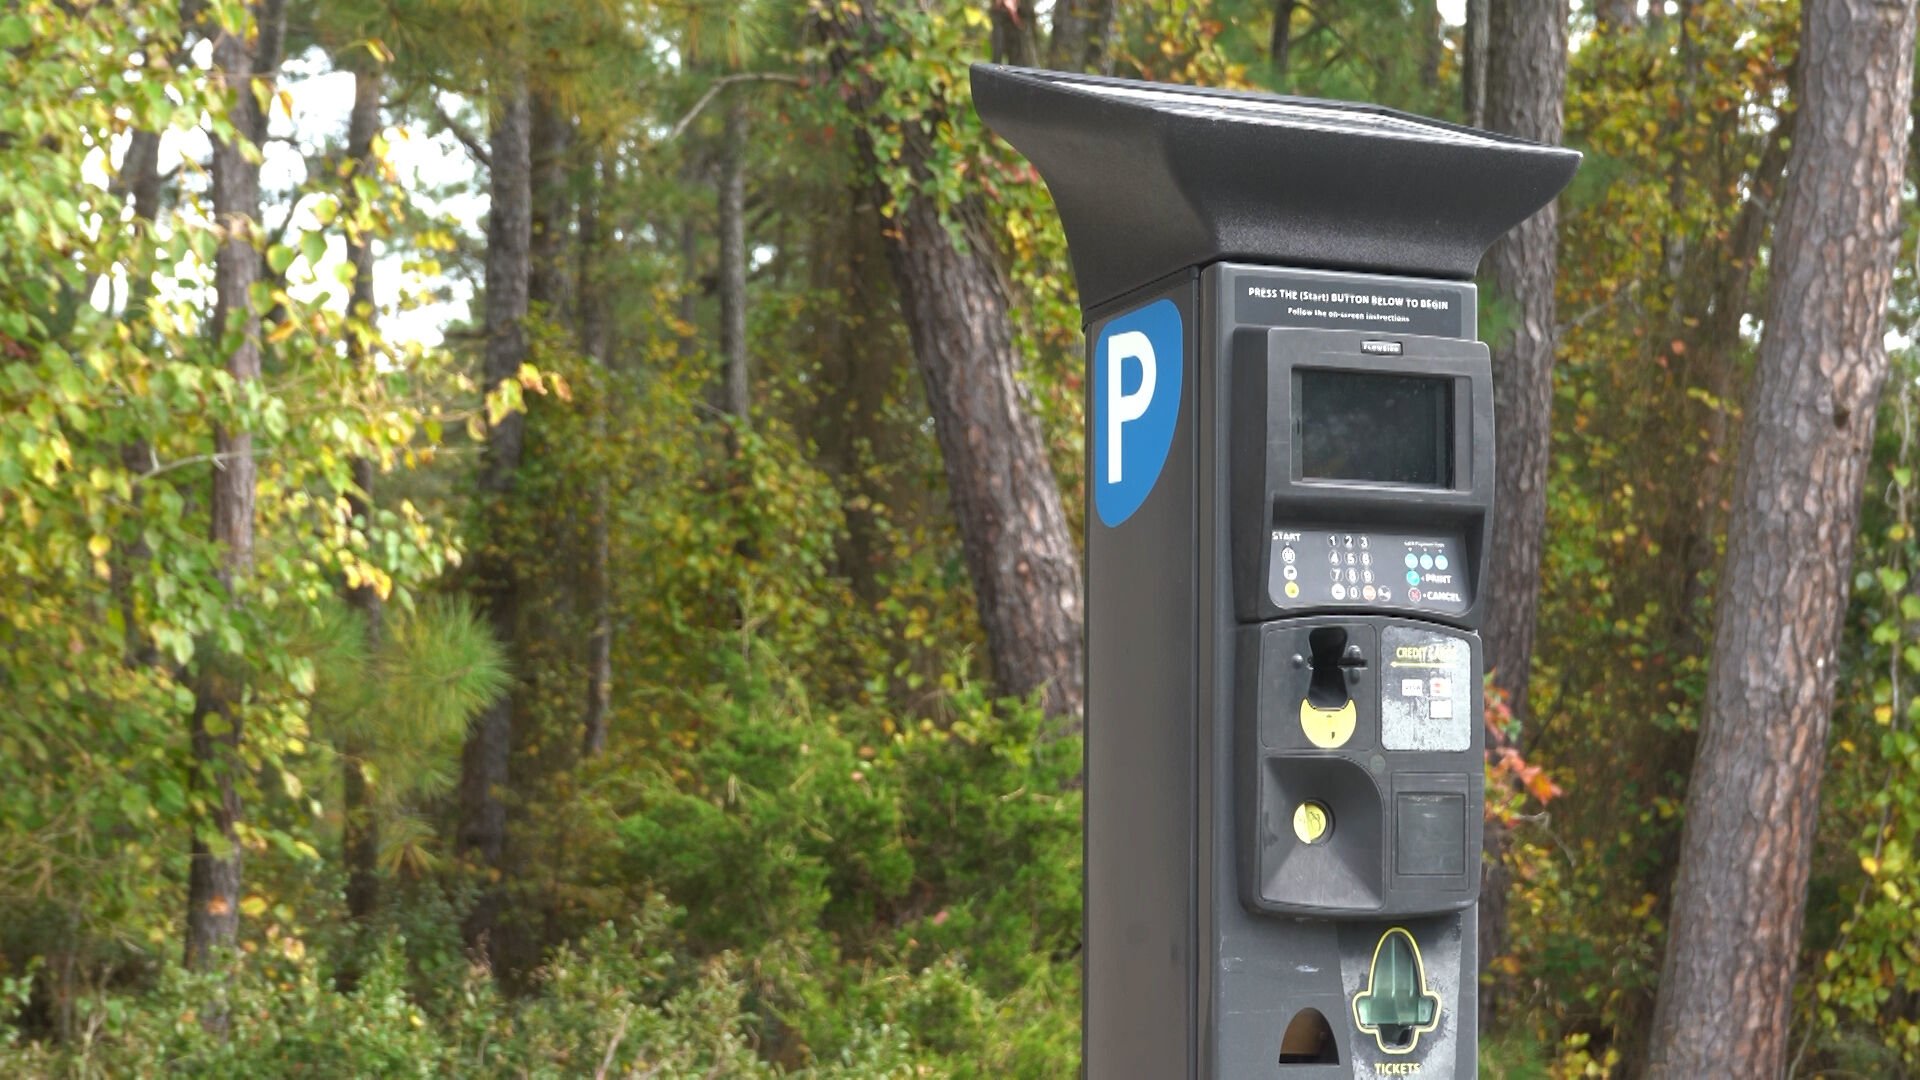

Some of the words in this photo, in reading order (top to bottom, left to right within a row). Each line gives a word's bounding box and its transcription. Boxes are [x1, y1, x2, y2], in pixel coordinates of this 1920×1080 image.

[1248, 287, 1277, 299] PRESS
[1279, 289, 1298, 300] THE
[1300, 291, 1329, 302] (Start)
[1331, 293, 1369, 304] BUTTON
[1371, 295, 1404, 306] BELOW
[1406, 298, 1419, 308] TO
[1420, 299, 1449, 310] BEGIN
[1287, 307, 1313, 316] Follow
[1314, 309, 1327, 317] the
[1366, 312, 1410, 322] instructions
[1108, 331, 1157, 484] P
[1272, 531, 1301, 542] START
[1426, 591, 1462, 602] CANCEL
[1396, 647, 1426, 662] CREDIT
[1374, 1062, 1421, 1075] TICKETS
